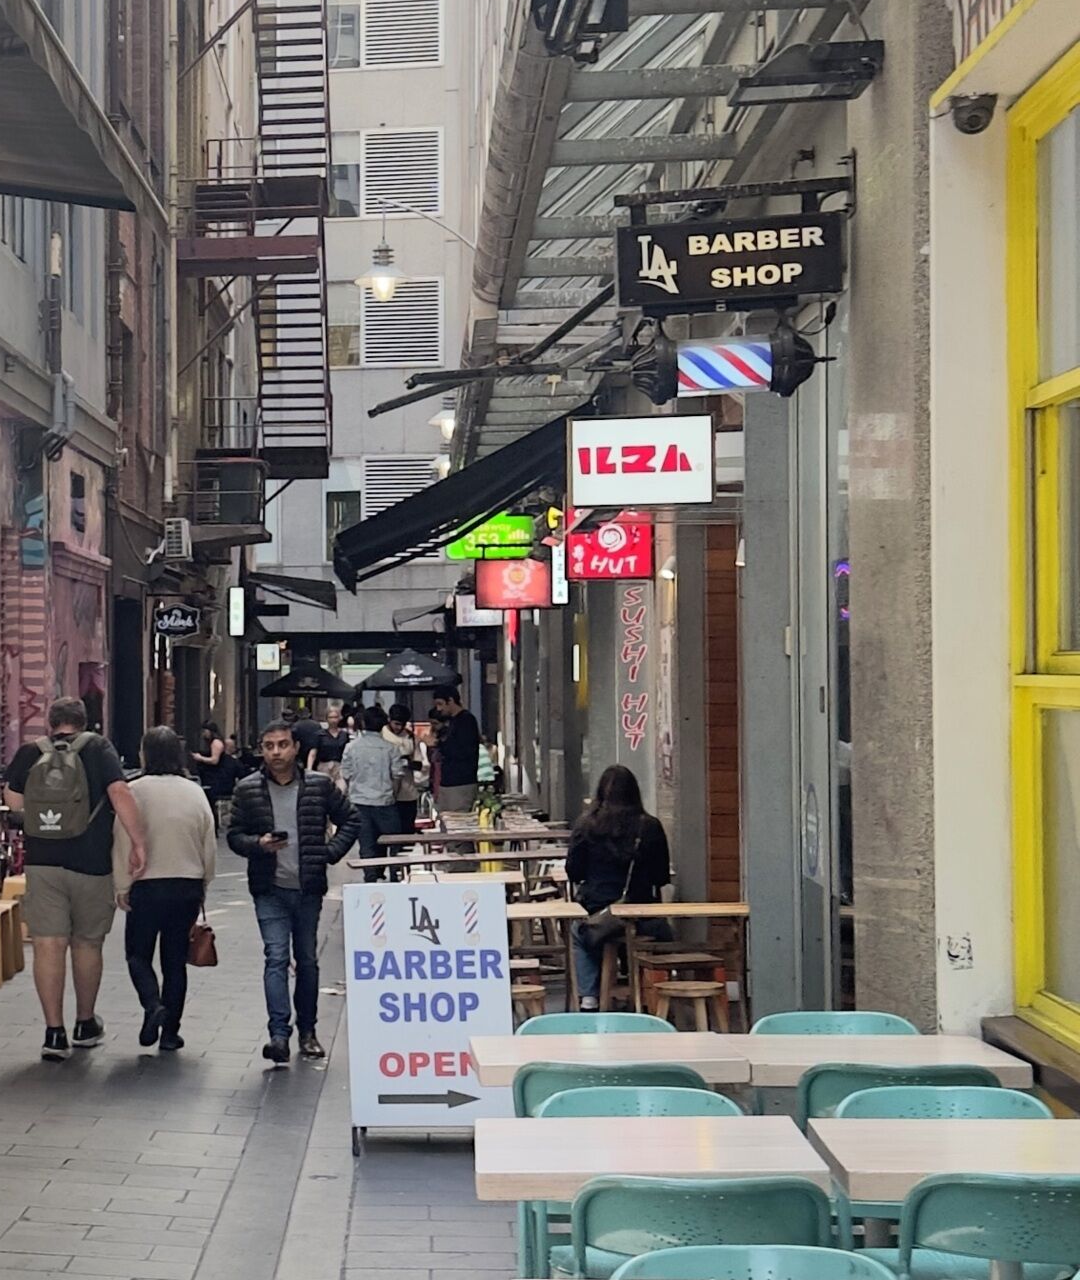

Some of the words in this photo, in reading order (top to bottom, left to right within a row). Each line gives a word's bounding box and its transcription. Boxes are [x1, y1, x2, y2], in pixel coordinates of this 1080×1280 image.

[687, 226, 825, 256] BARBER
[710, 262, 803, 289] SHOP
[577, 444, 693, 475] ILZA
[464, 532, 500, 552] 353
[555, 549, 564, 598] IZZA
[590, 555, 638, 575] HUT
[621, 586, 647, 683] SUSHI
[621, 693, 649, 751] HUT
[408, 897, 441, 945] LA
[353, 949, 504, 980] BARBER
[379, 992, 480, 1022] SHOP
